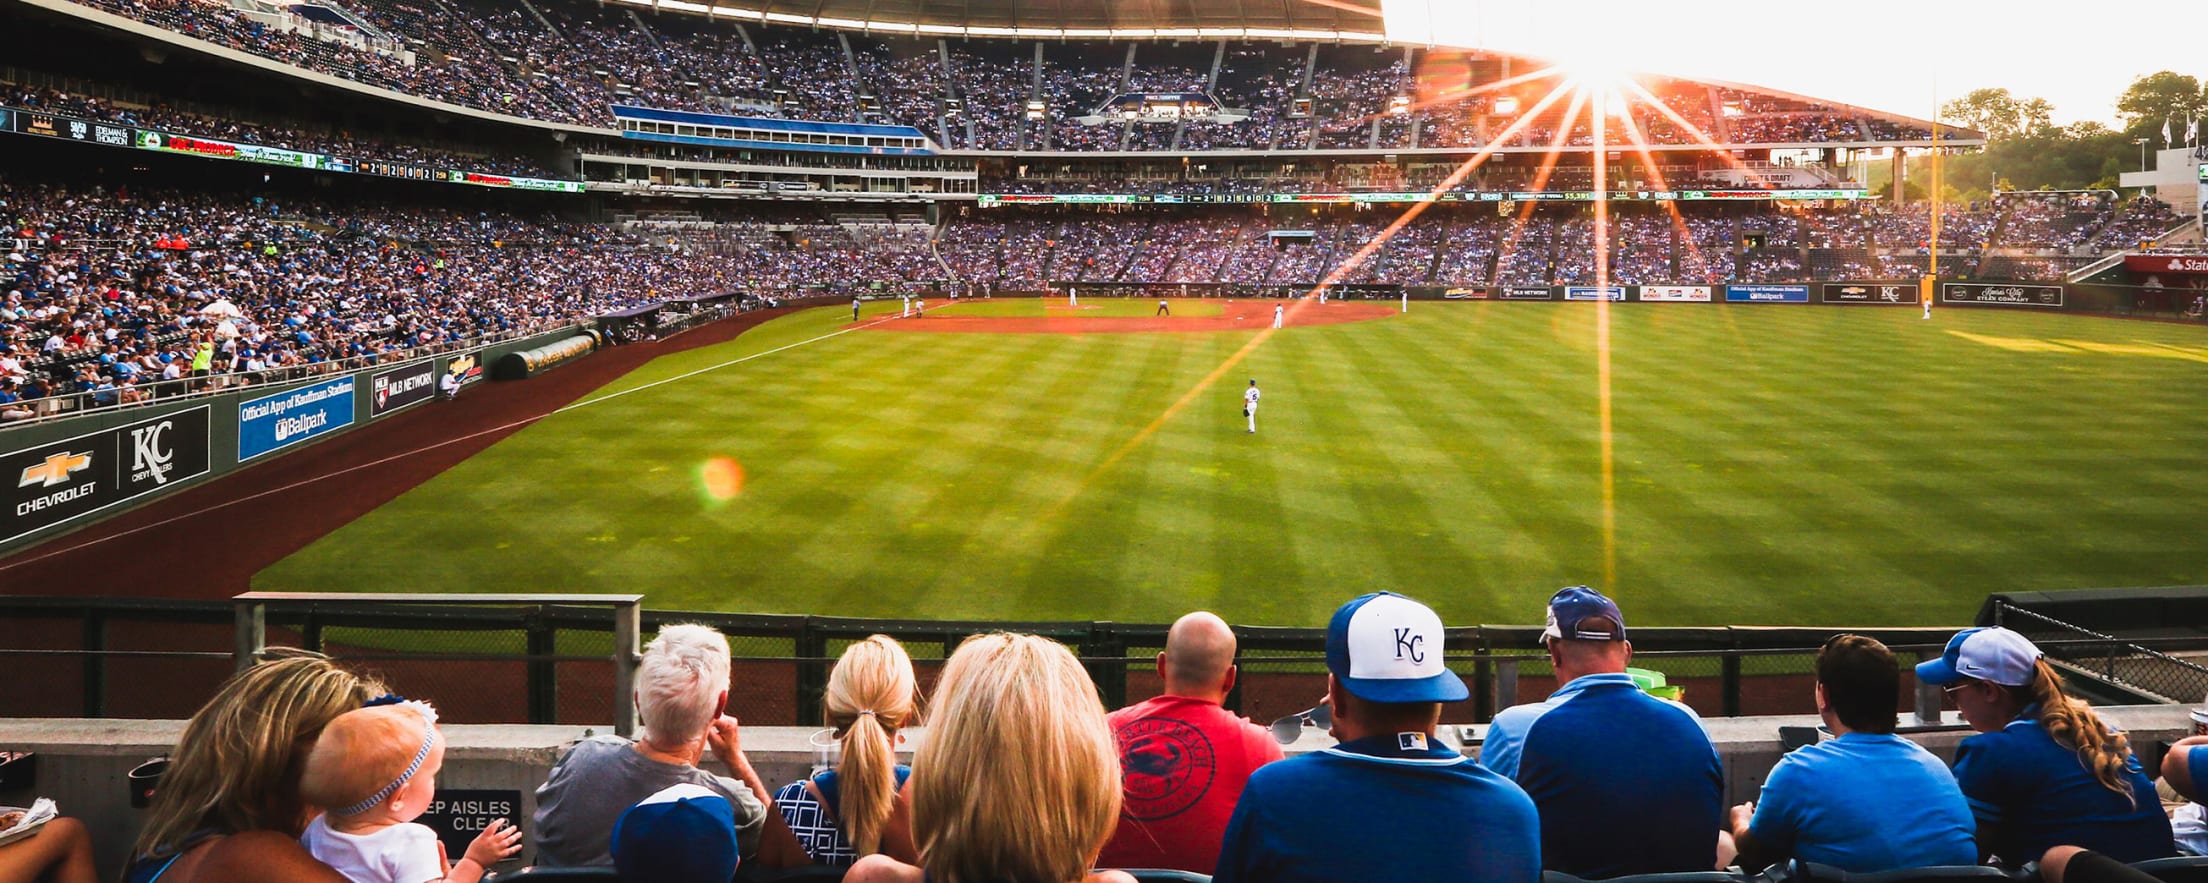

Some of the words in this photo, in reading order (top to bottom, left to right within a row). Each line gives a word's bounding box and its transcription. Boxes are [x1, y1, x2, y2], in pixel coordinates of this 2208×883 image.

[95, 125, 122, 138] EDELMAN
[122, 128, 128, 138] &
[96, 134, 128, 148] THOMPSON
[193, 139, 237, 157] PRODUCE
[371, 163, 376, 174] 2
[391, 165, 396, 176] 2
[424, 169, 430, 179] 2
[2184, 258, 2208, 271] Stat
[1756, 292, 1784, 301] Ballpark
[1880, 286, 1900, 302] KC
[389, 380, 403, 398] MLB
[403, 370, 433, 394] NETWORK
[241, 401, 269, 422] Official
[269, 400, 286, 416] App
[286, 395, 294, 410] of
[294, 390, 328, 408] Kauffman
[327, 382, 353, 398] Stadium
[287, 408, 327, 437] Ballpark
[131, 421, 173, 485] KC
[131, 470, 151, 483] CHEVY
[16, 481, 97, 518] CHEVROLET
[1393, 627, 1425, 664] KC
[425, 801, 446, 815] EP
[450, 801, 511, 815] AISLES
